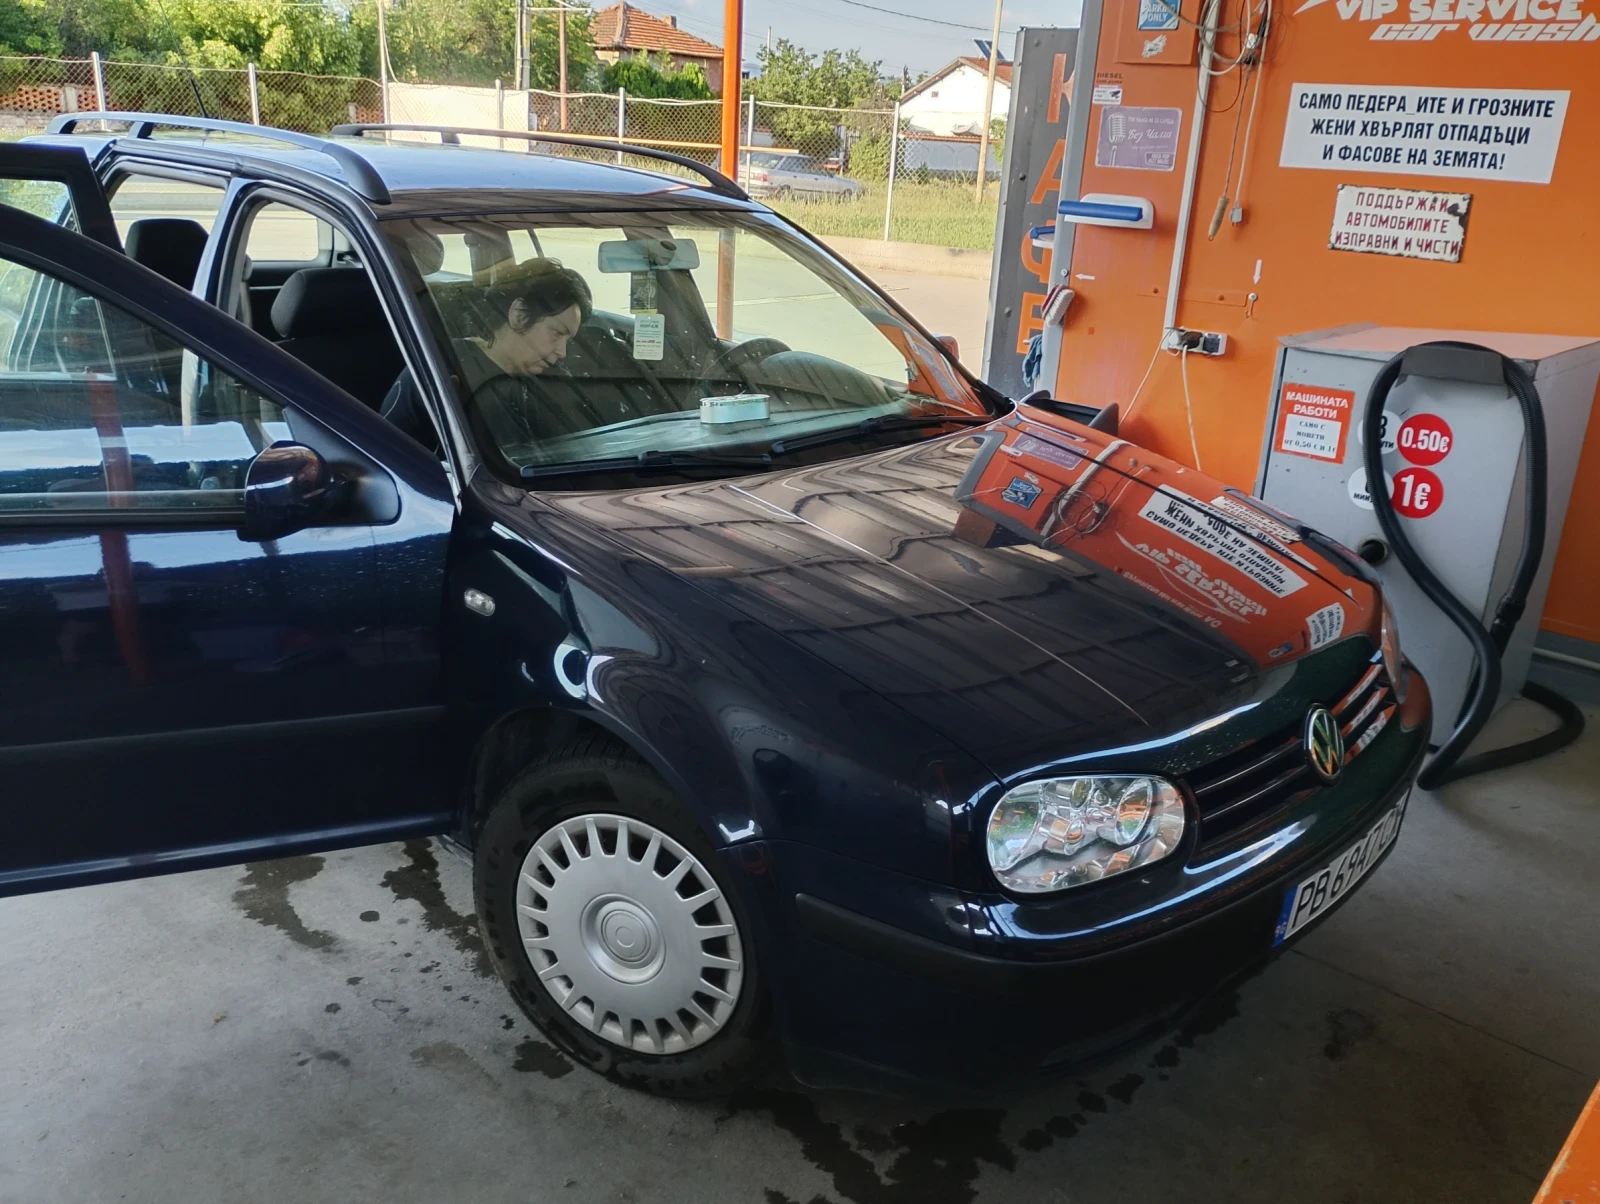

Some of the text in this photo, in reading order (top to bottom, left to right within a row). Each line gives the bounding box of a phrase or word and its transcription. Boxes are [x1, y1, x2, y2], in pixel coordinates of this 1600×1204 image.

[1335, 0, 1584, 23] VIP SERVICE
[1369, 12, 1600, 41] car wash
[1299, 92, 1342, 110] САМО
[1451, 97, 1465, 114] И
[1468, 98, 1555, 118] ГРОЗНИТЕ
[1310, 118, 1531, 146] ЖЕНИ ХВЪРЛЯТ ОТПАДЪЦИ
[1322, 144, 1505, 170] И ФАСОВЕ НА ЗЕМЯТА!
[1345, 211, 1450, 234] АВТОМОБИЛИТЕ
[1334, 231, 1459, 256] ИЗПРАВНИ И ЧИСТИ
[1286, 391, 1348, 408] МАШИНАТА
[1293, 404, 1338, 419] РАБОТИ
[1296, 430, 1325, 440] МОНЕТИ
[1299, 420, 1318, 429] САМО
[1401, 427, 1450, 453] 0.50€
[1400, 474, 1431, 510] 1€
